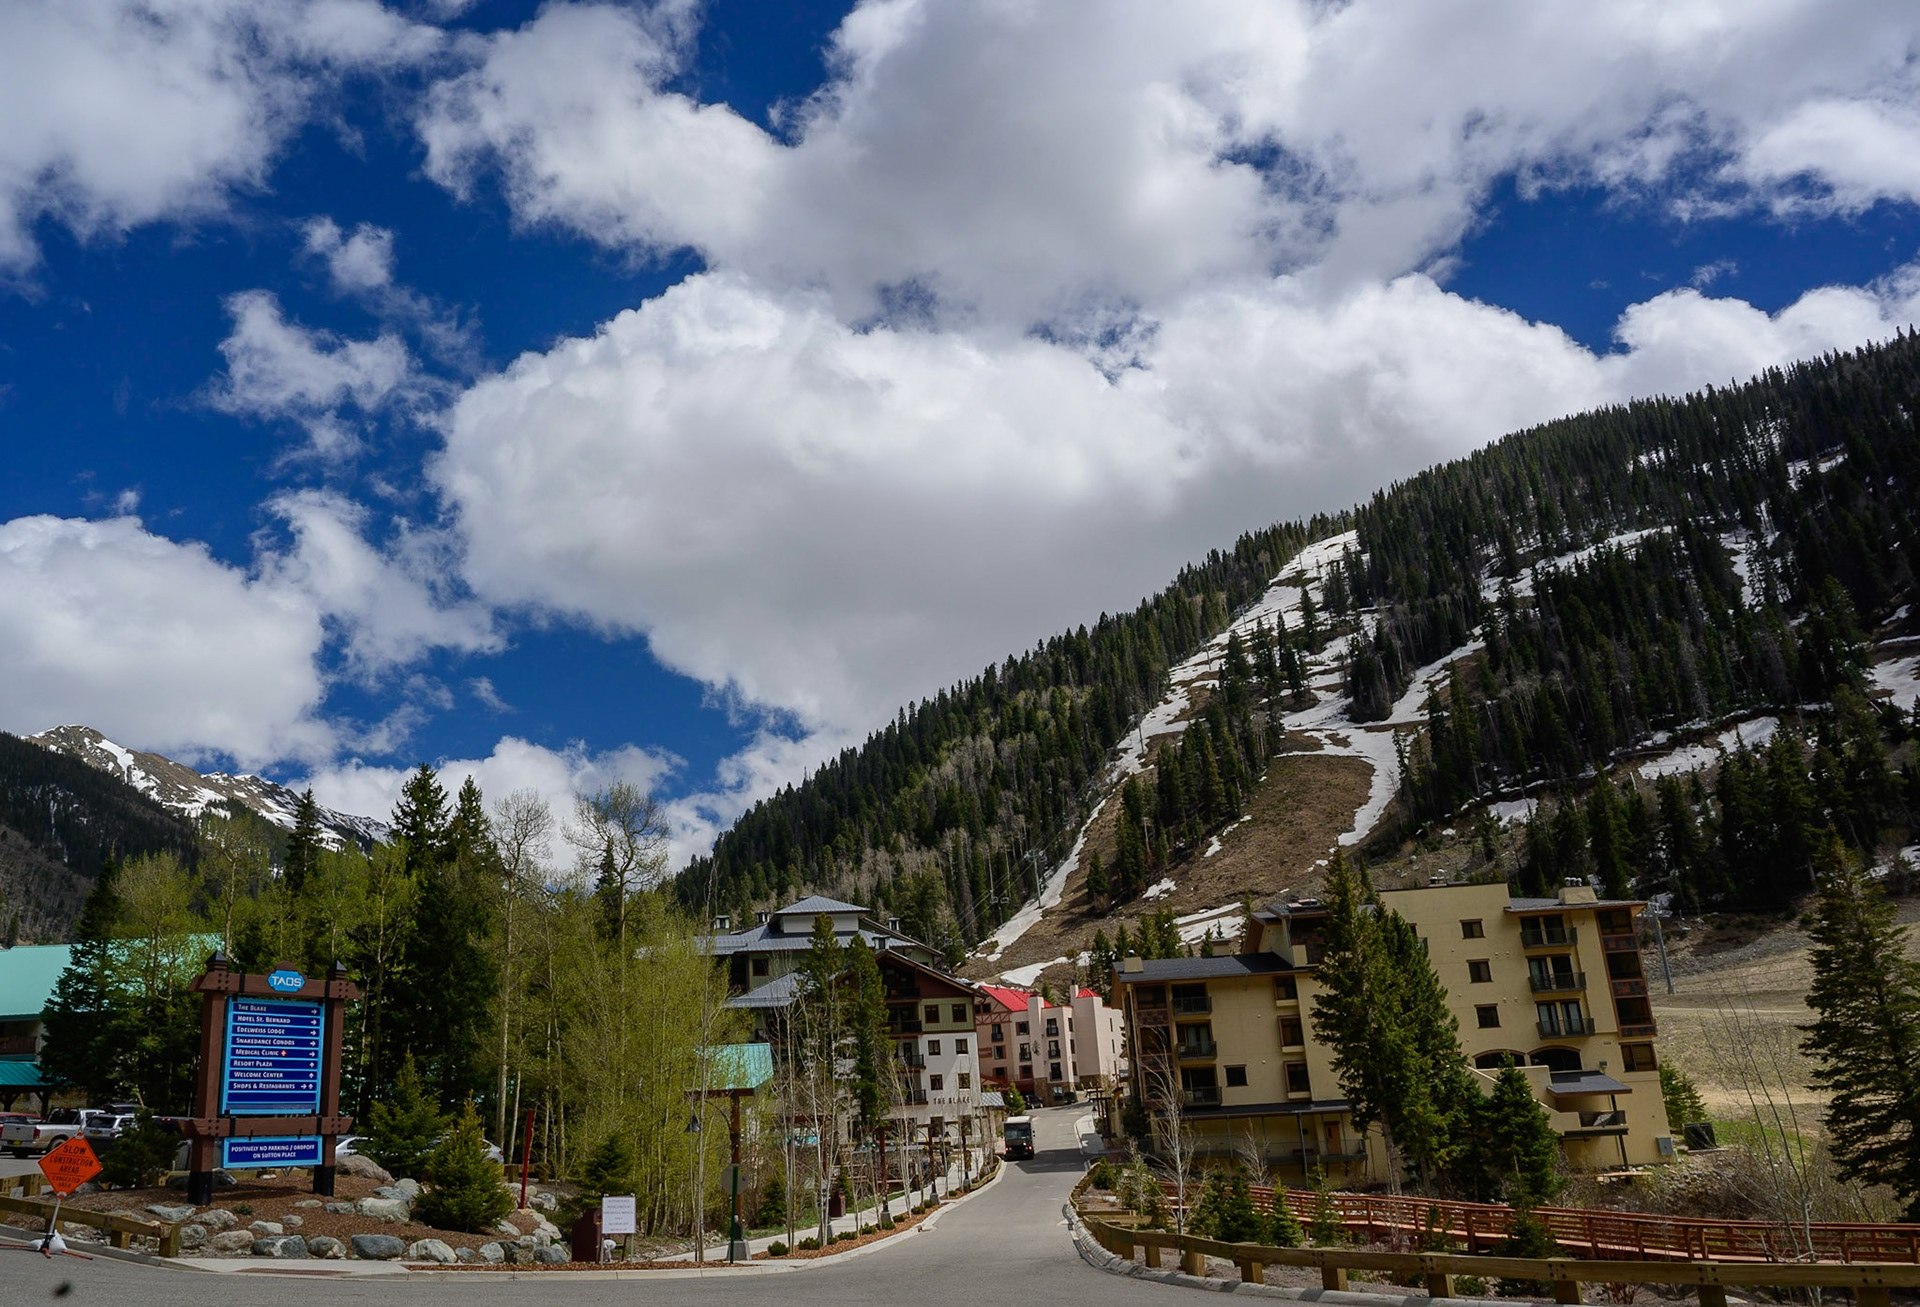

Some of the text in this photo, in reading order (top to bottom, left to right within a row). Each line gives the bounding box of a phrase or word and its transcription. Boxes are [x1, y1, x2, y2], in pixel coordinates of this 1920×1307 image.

[272, 975, 302, 987] TAOS
[250, 1004, 267, 1012] BLAKE
[267, 1027, 285, 1035] LODGE
[236, 1037, 295, 1046] SNAKEDANCE CONDOS
[235, 1048, 260, 1056] MEDICAL
[258, 1082, 295, 1090] RESTAURANTS
[948, 1096, 970, 1104] BLAKE
[63, 1145, 86, 1155] SLOW
[49, 1156, 93, 1167] CONSTRUCTION
[59, 1165, 79, 1174] AHEAD
